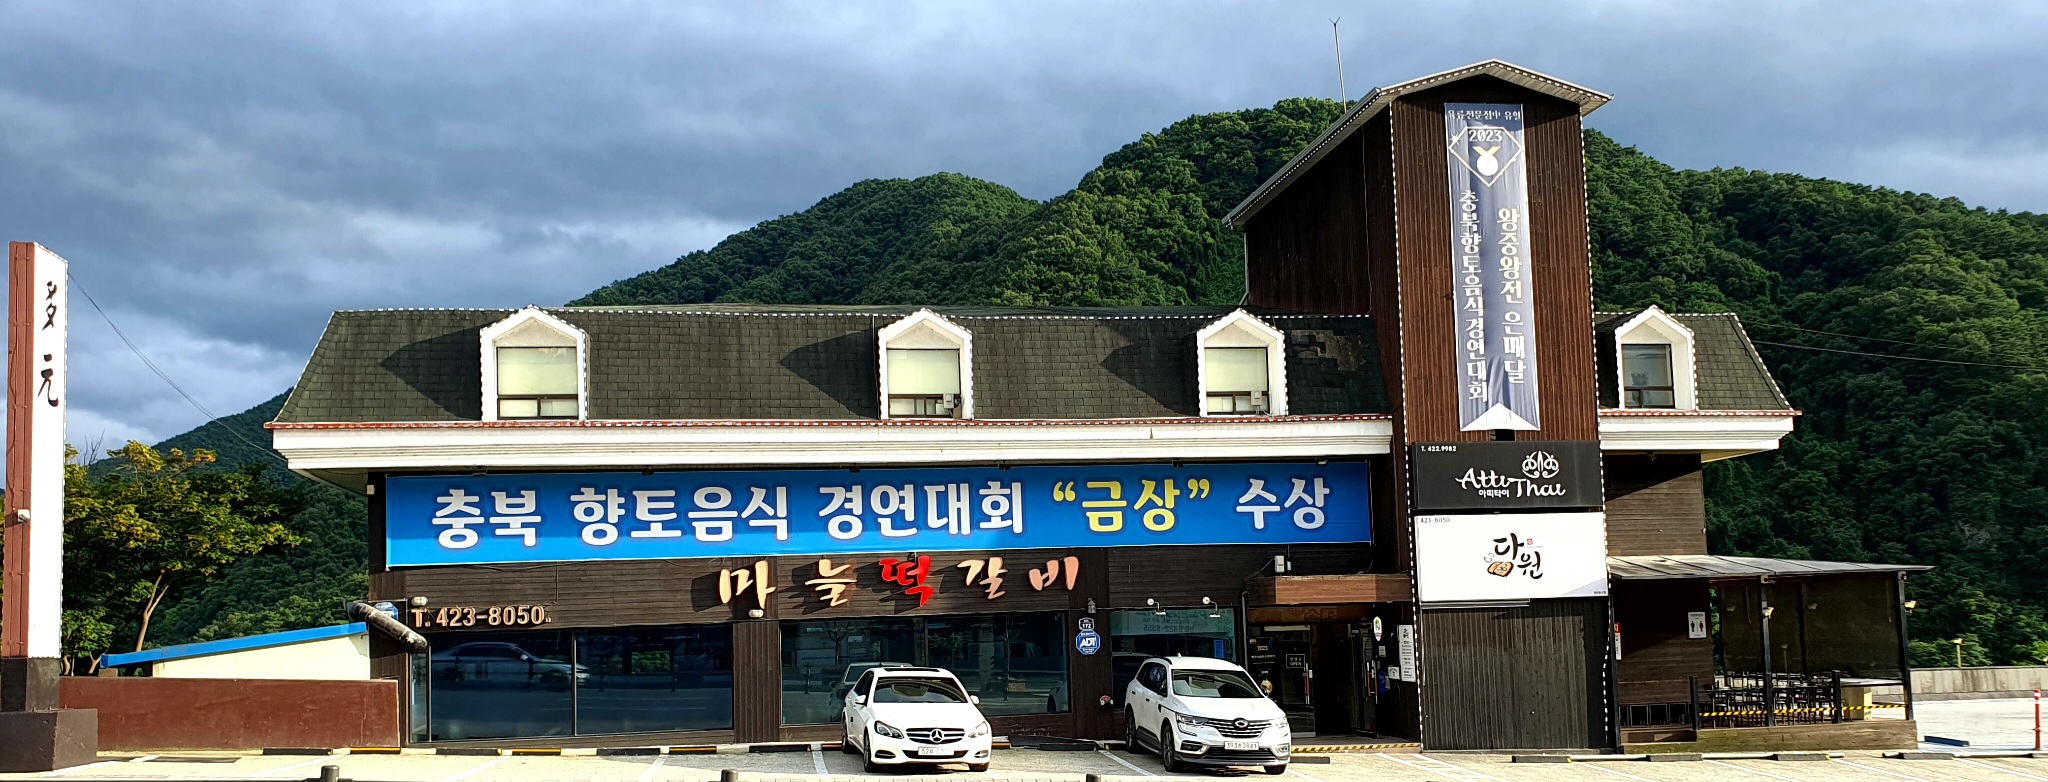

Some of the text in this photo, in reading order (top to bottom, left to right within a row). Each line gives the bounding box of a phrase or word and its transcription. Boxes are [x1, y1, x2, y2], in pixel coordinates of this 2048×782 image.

[1504, 110, 1521, 120] 유일
[1468, 129, 1503, 142] 2023
[1497, 208, 1527, 384] 왕중왕전 은메달
[1455, 467, 1566, 498] Atti Thai
[431, 477, 1330, 549] 충북 향토음식 경연대회 “금상” 수상
[1492, 532, 1544, 580] 다원
[1080, 637, 1097, 647] ADT
